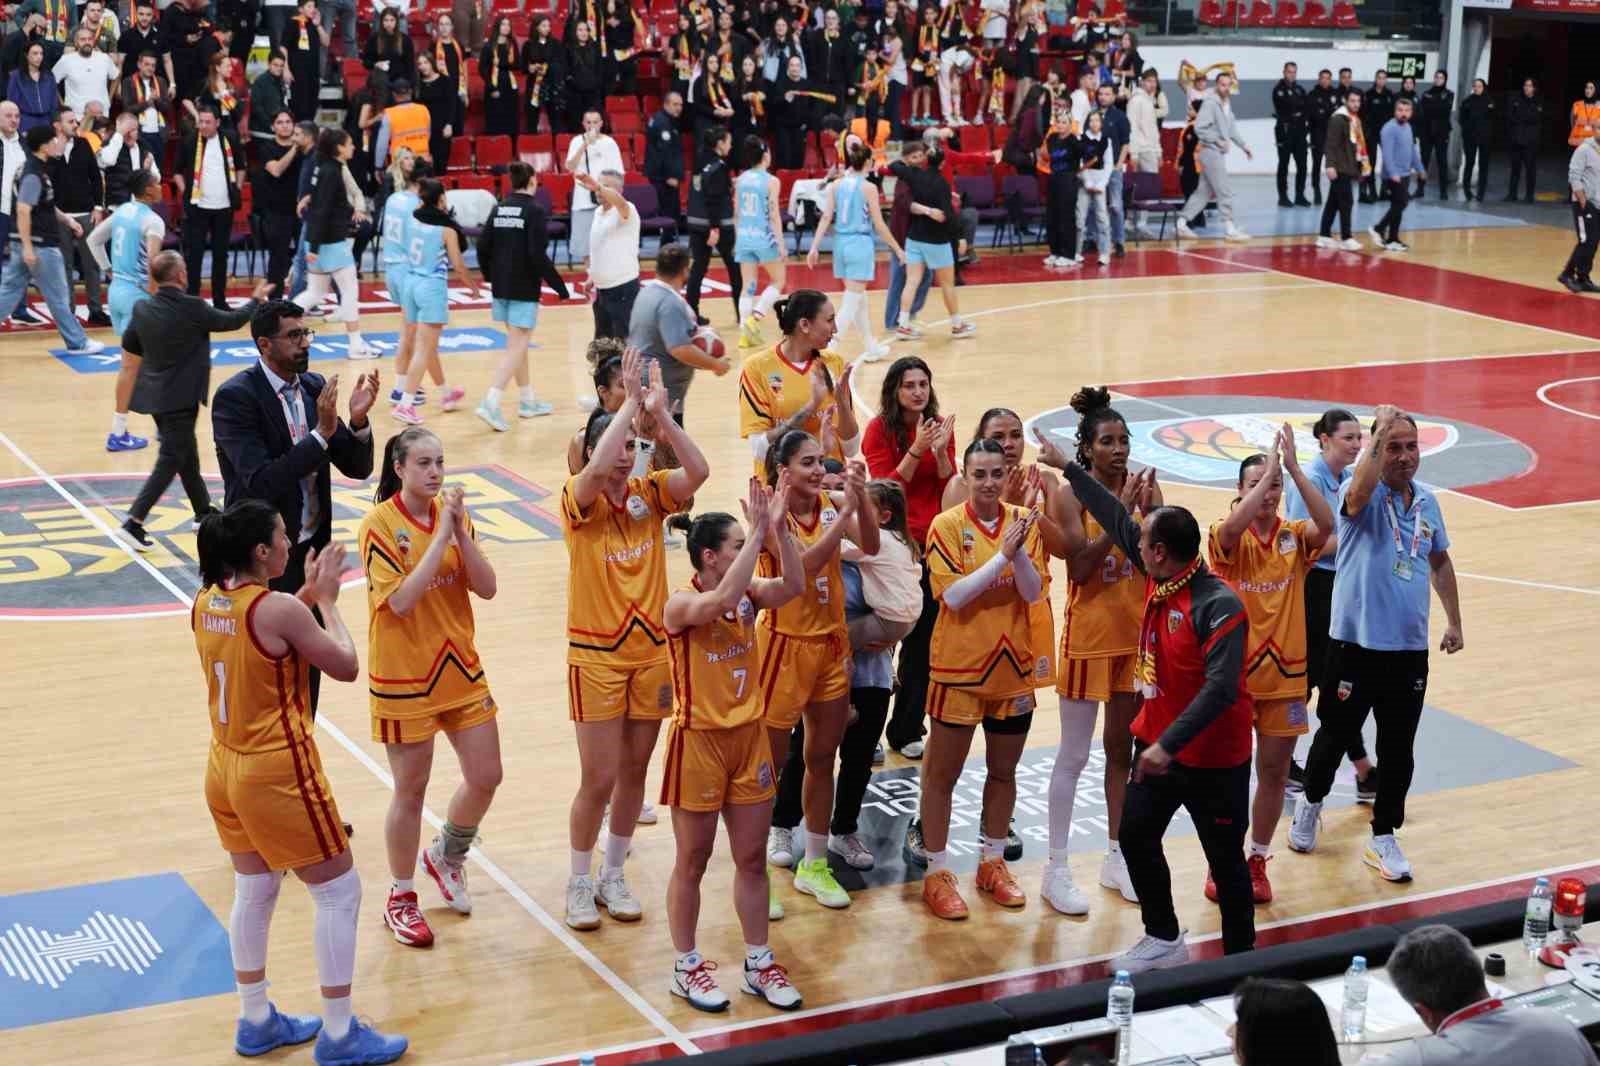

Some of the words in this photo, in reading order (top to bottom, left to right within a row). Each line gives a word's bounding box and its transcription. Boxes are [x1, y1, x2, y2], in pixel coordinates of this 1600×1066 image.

[1103, 554, 1134, 582] 24
[815, 575, 830, 605] 5
[214, 661, 228, 724] 1
[732, 668, 747, 698] 7
